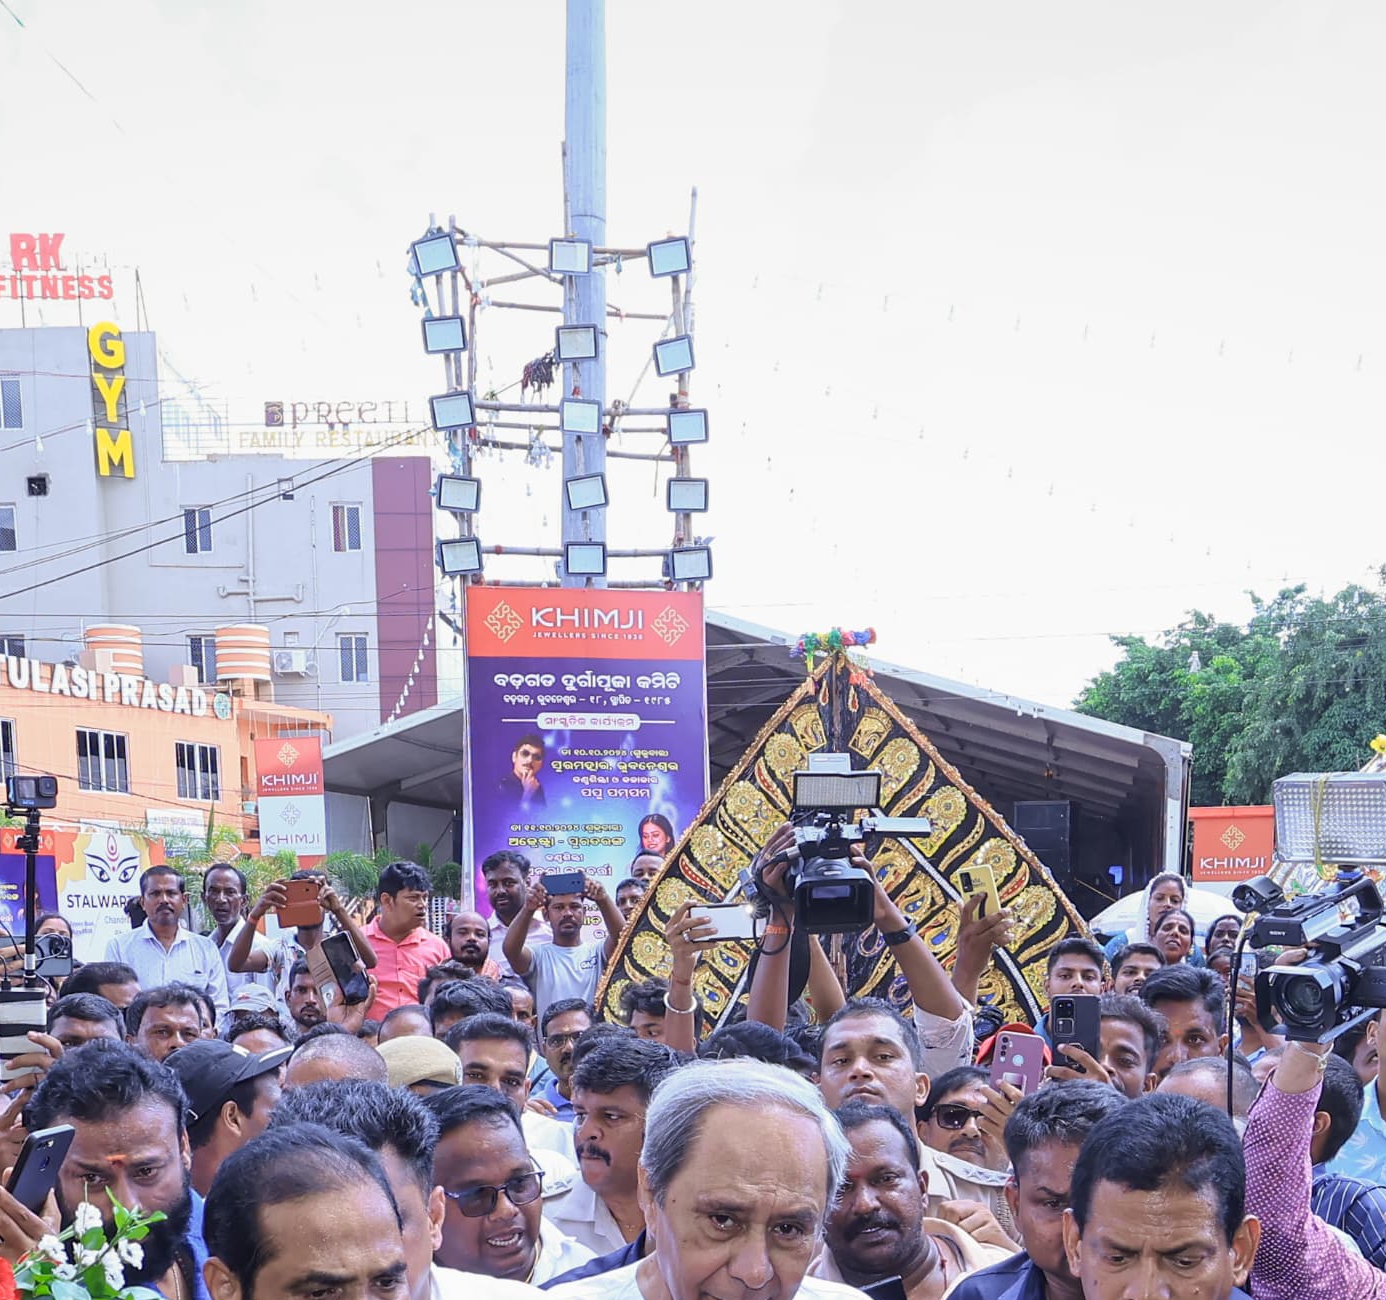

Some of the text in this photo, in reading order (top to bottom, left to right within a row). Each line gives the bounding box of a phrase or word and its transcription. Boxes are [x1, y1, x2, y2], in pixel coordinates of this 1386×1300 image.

[9, 233, 65, 271] RK
[88, 321, 135, 478] GYM
[239, 431, 305, 449] FAMILY
[532, 607, 643, 629] KHIMJI
[532, 631, 586, 639] JEWELLERS
[636, 672, 681, 689] କମିଟି
[104, 672, 206, 716] PRASAD
[261, 773, 317, 786] KHIMJI
[265, 833, 320, 845] KHIMJI
[1200, 857, 1264, 869] KHIMJI
